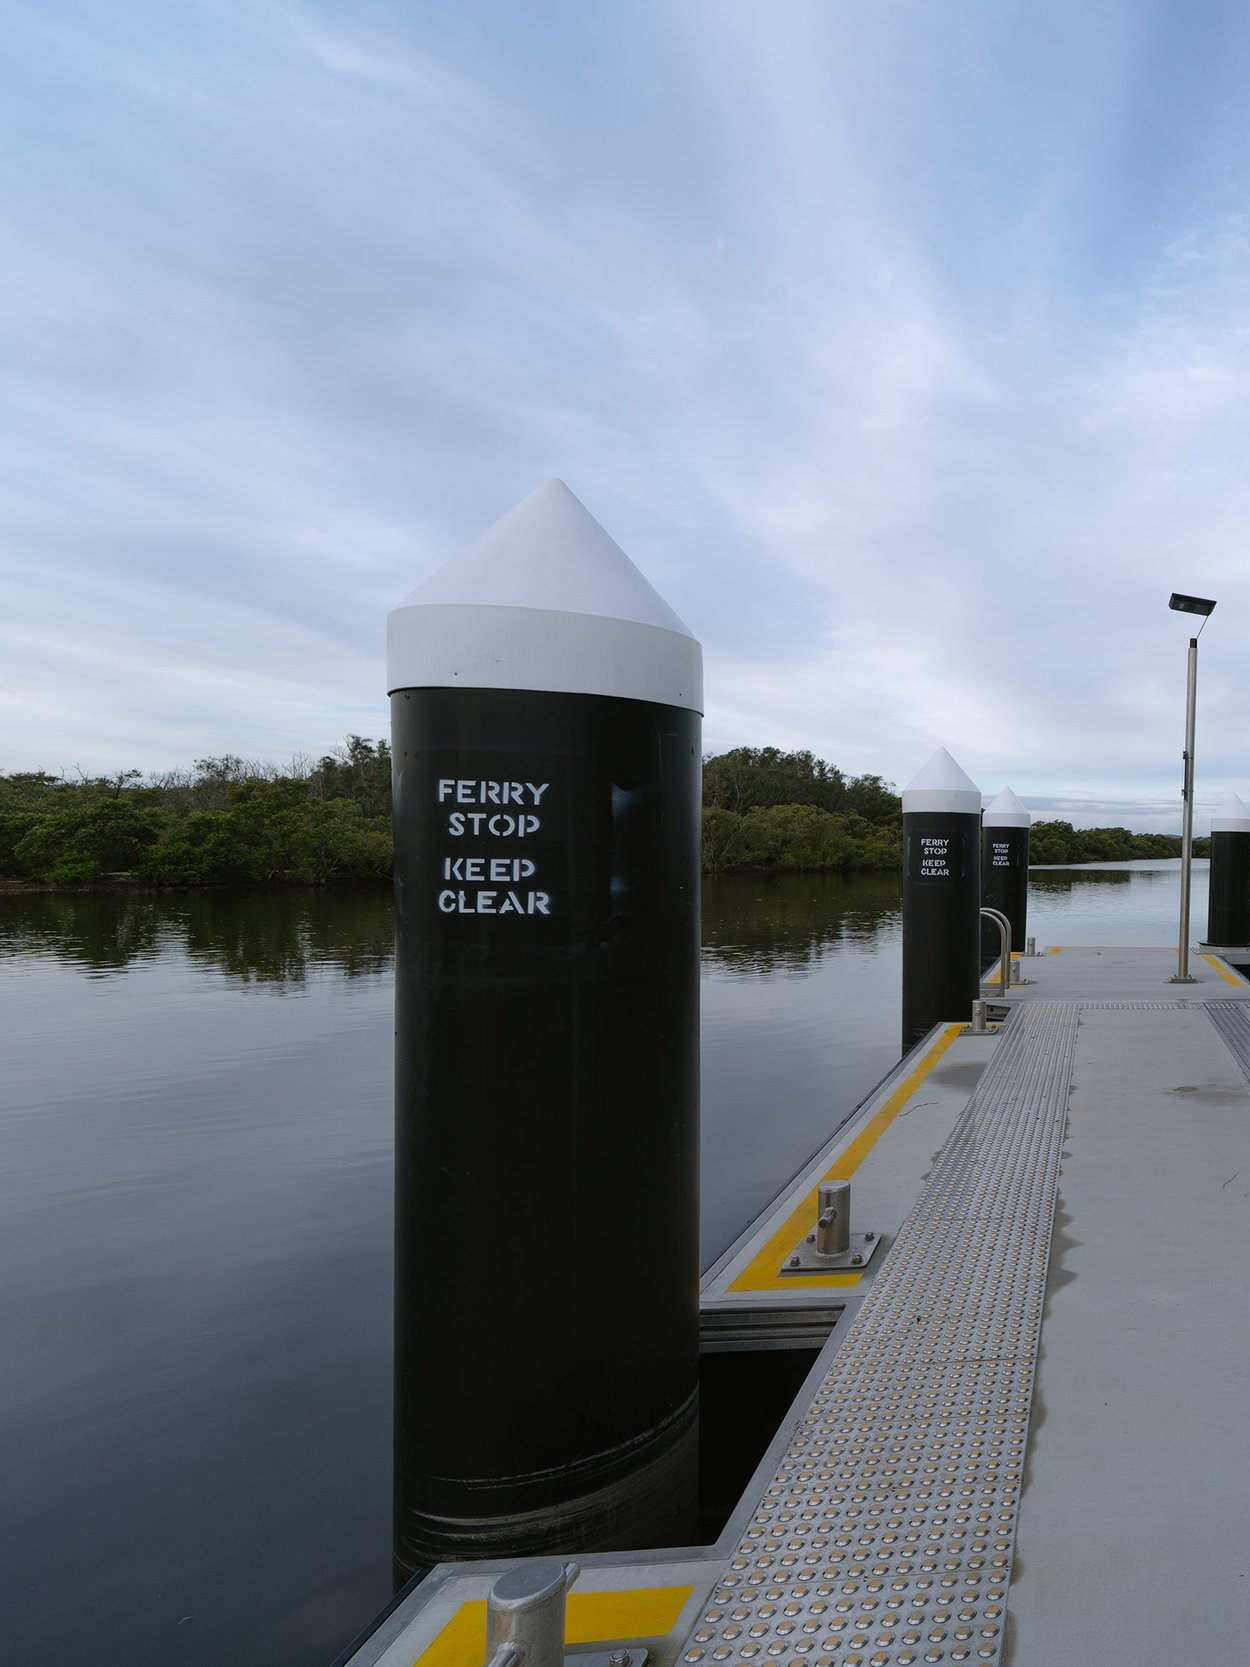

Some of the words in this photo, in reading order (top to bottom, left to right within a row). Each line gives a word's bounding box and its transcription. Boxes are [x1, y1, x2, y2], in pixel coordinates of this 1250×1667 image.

[438, 779, 550, 806] FERRY
[449, 812, 540, 837] STOP
[920, 838, 950, 847] FERRY
[923, 847, 947, 855] STOP
[444, 857, 535, 882] KEEP
[922, 859, 946, 867] KEEP
[920, 868, 950, 876] CLEAR
[438, 889, 551, 914] CLEAR
